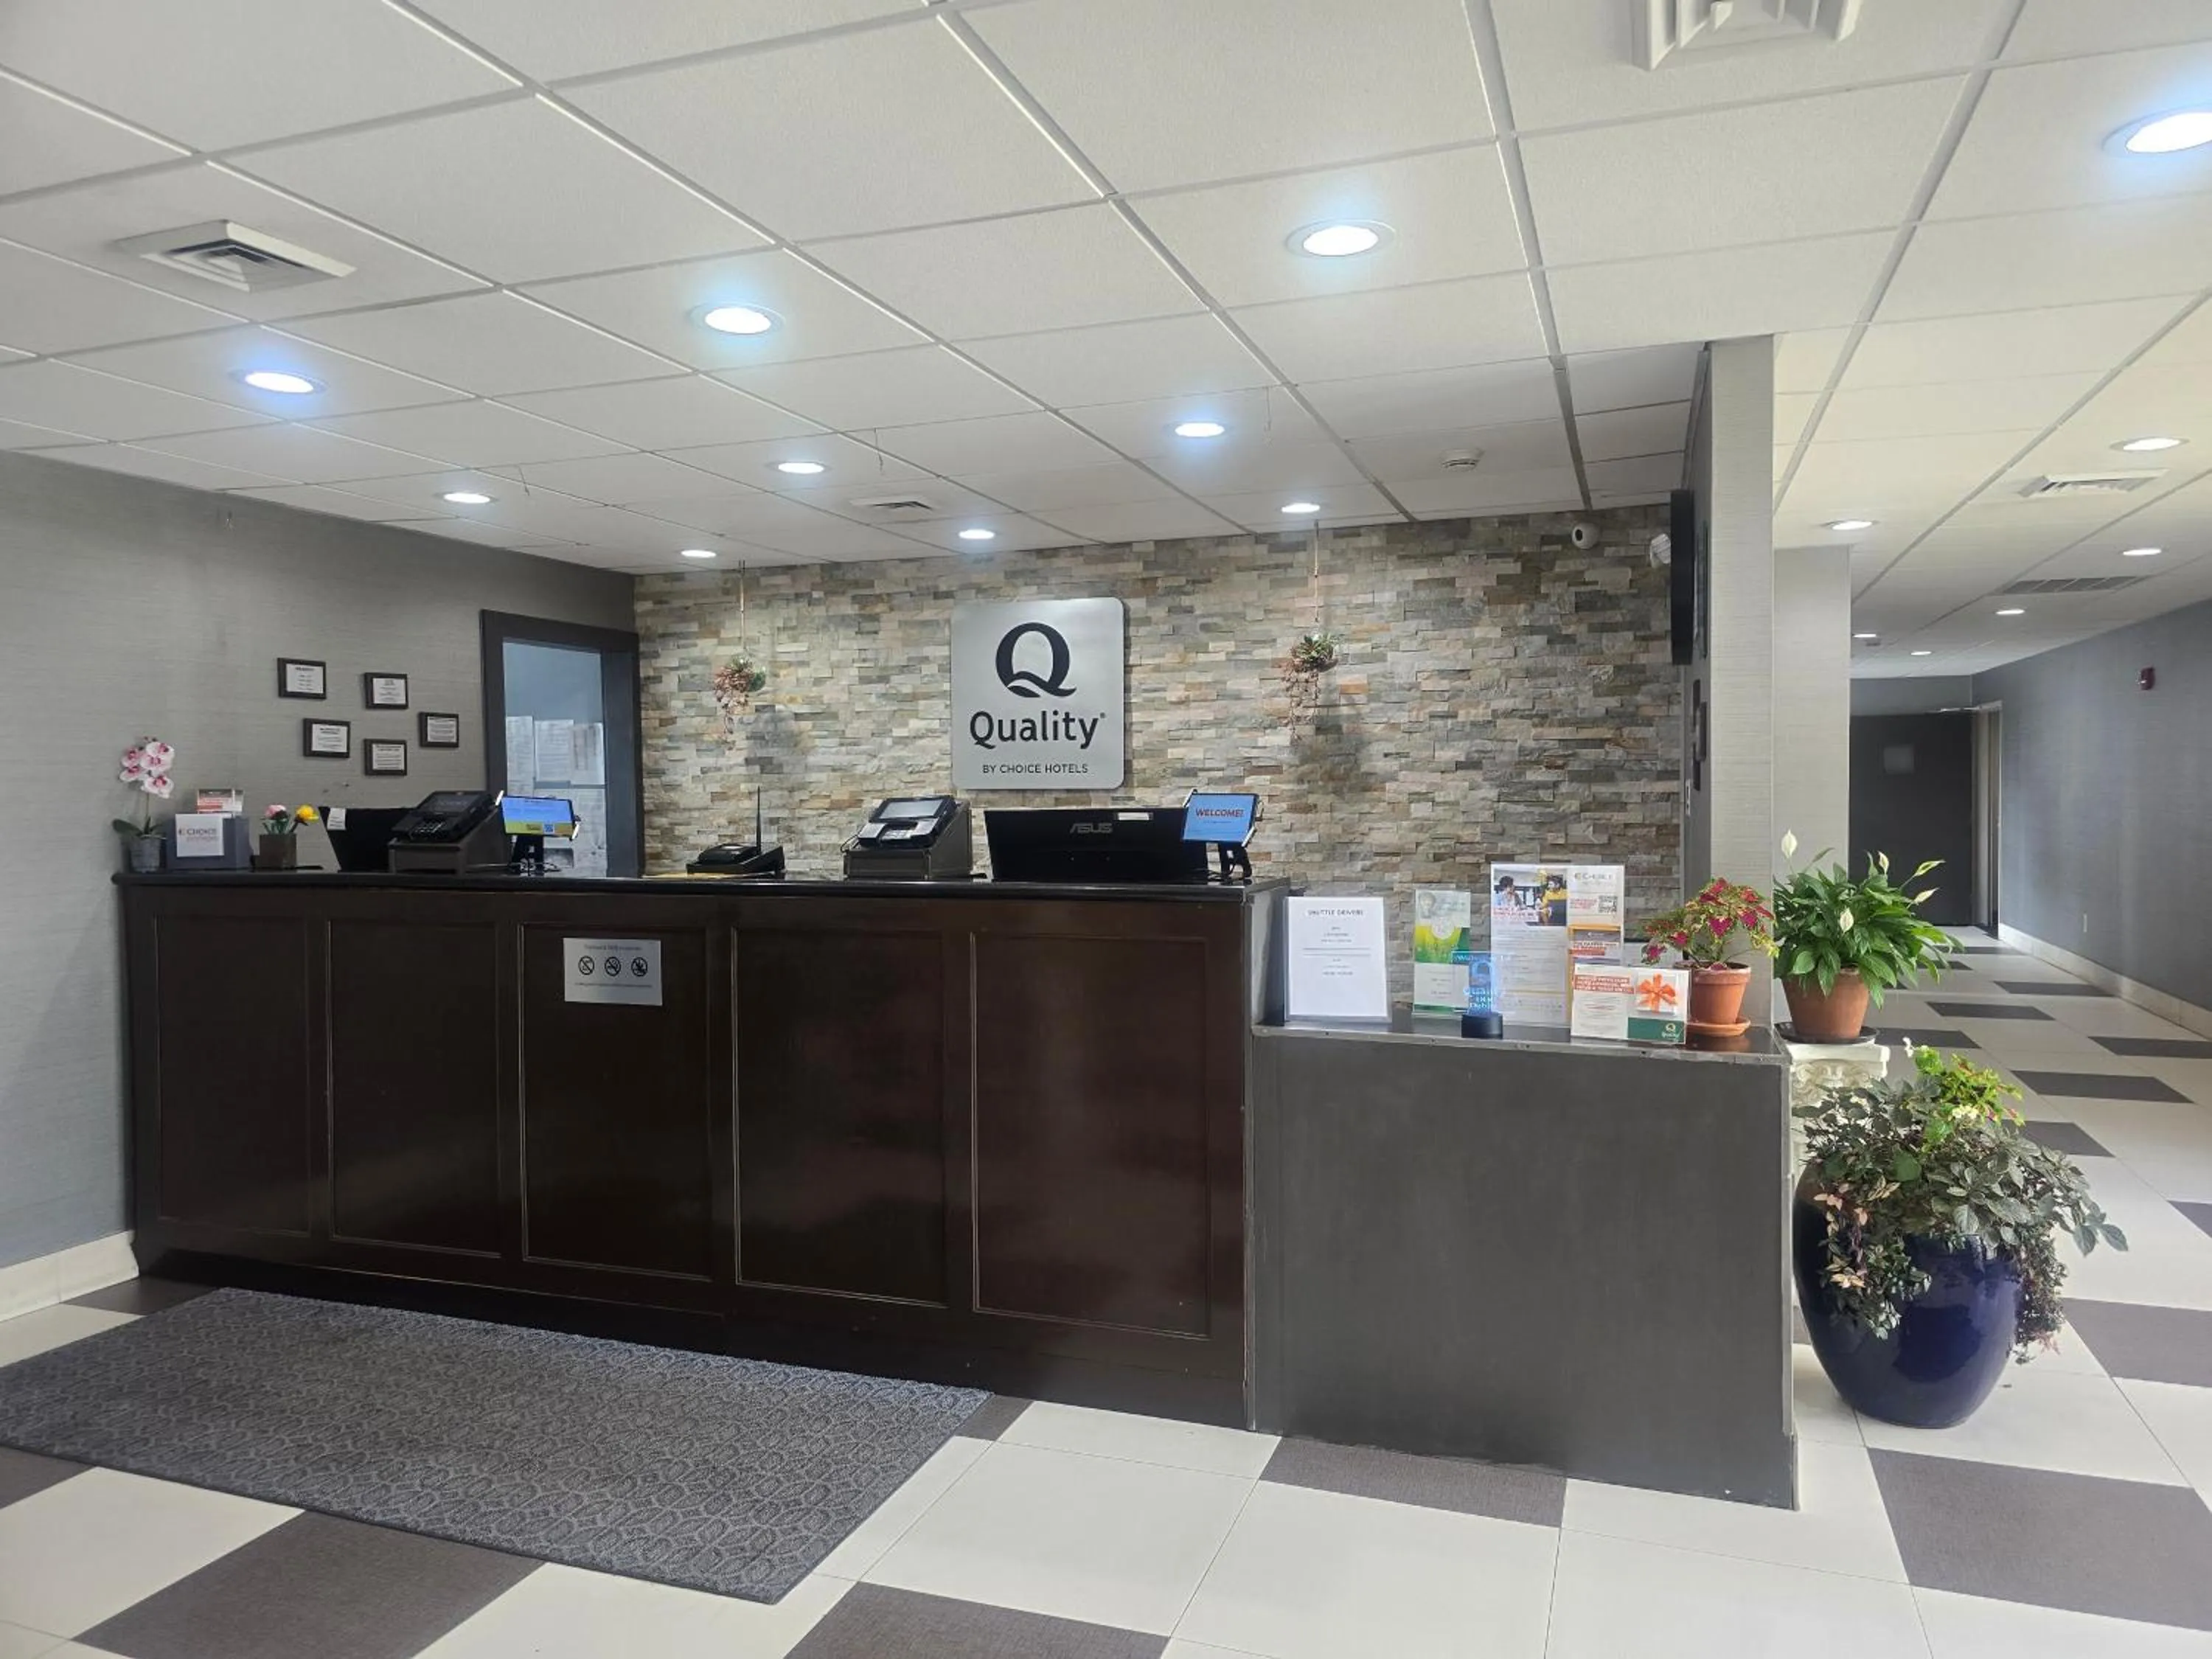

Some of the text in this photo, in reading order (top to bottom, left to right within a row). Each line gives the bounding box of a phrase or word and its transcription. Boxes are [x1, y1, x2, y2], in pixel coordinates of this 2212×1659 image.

[970, 710, 1099, 749] Quality
[983, 764, 1088, 773] BY CHOICE HOTELS
[1070, 822, 1113, 834] ASUS
